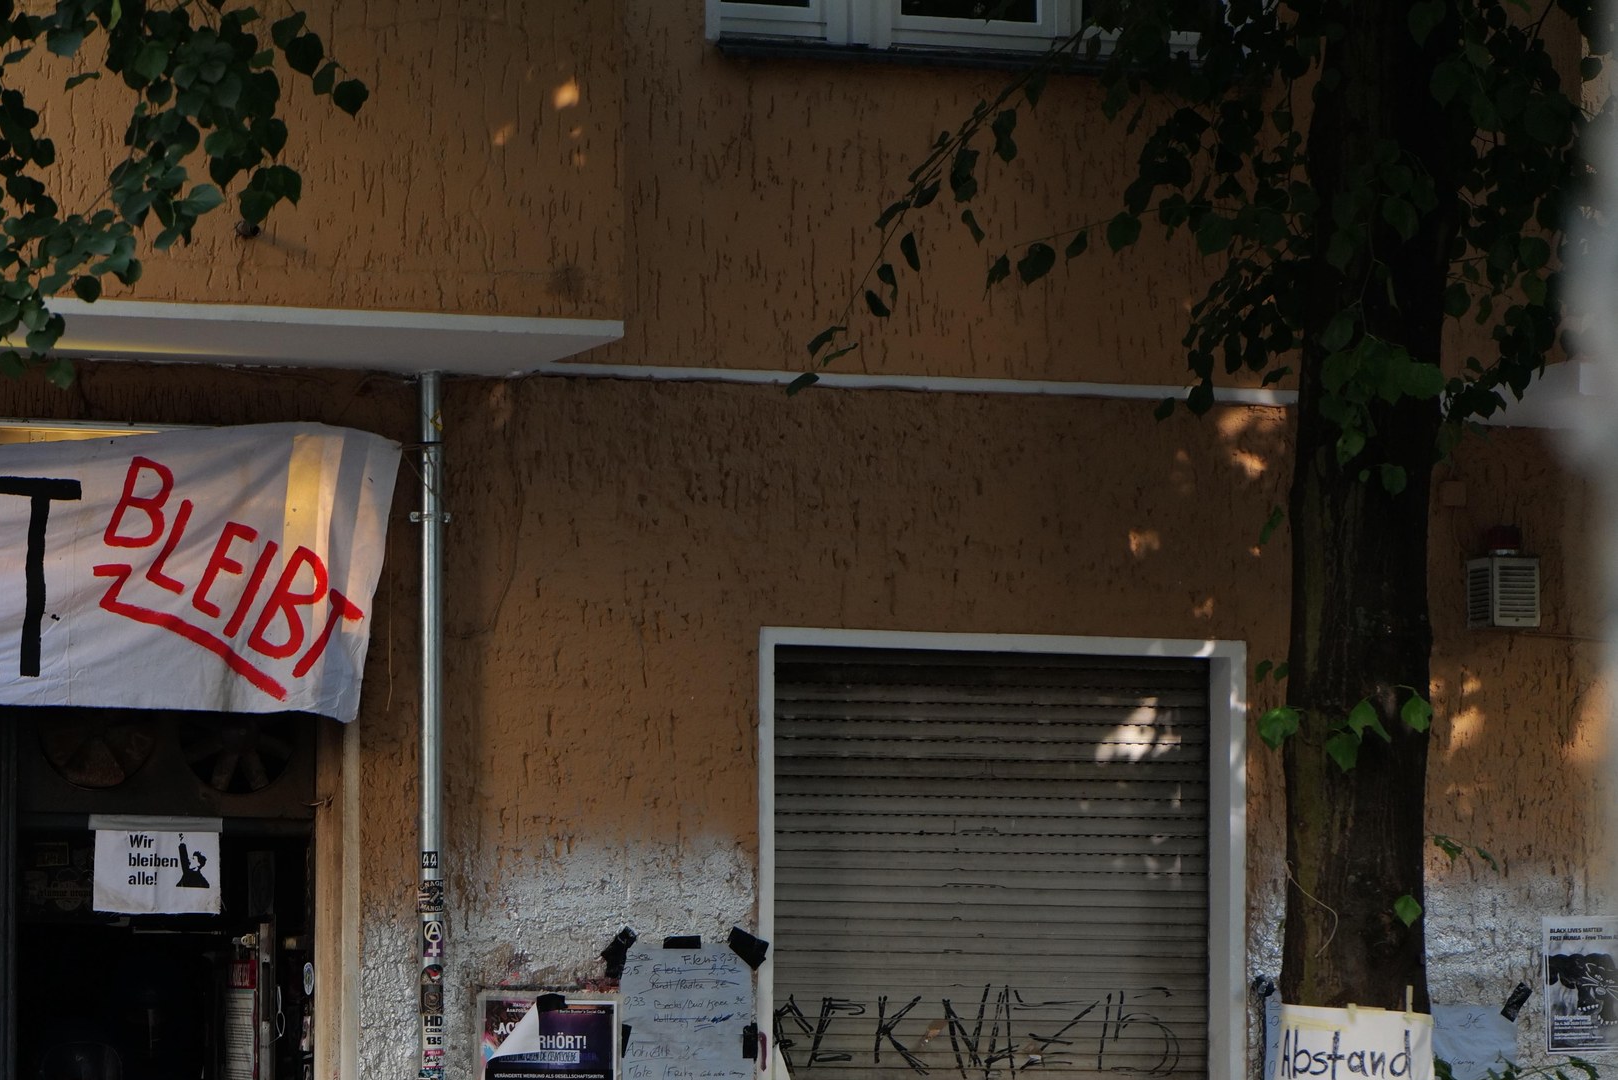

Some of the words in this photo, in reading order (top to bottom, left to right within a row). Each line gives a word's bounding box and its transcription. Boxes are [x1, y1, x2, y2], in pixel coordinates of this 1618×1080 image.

[103, 456, 363, 679] BLEIBT
[129, 834, 154, 849] Wir
[129, 853, 179, 868] bleiben
[128, 872, 158, 886] alle!
[424, 1016, 442, 1026] HD
[1282, 1025, 1412, 1080] Abstand
